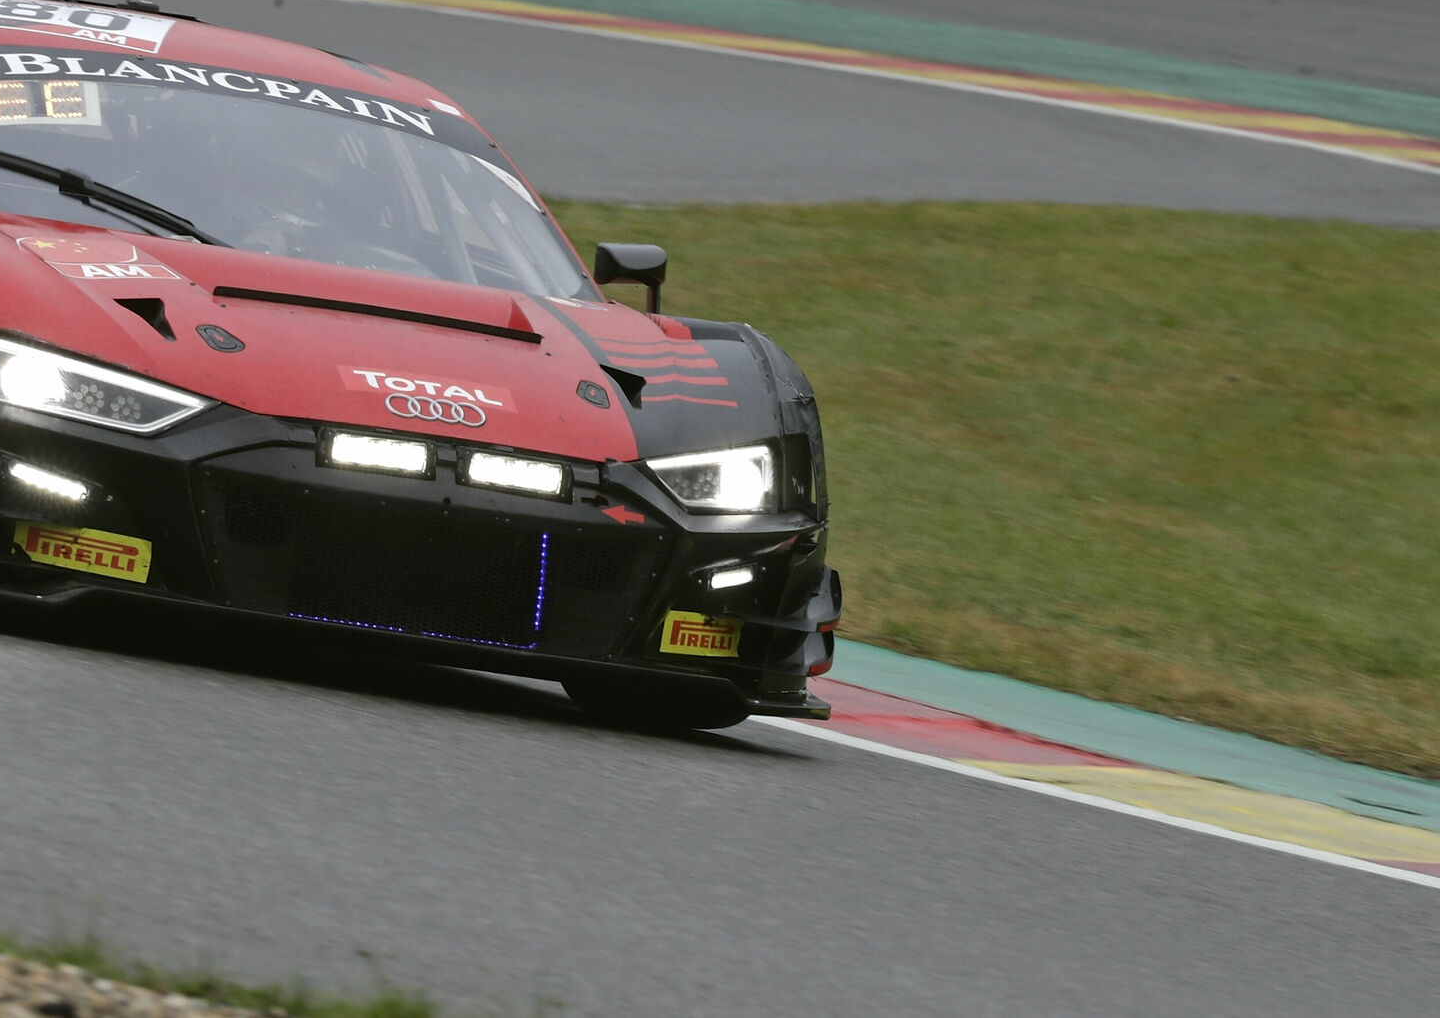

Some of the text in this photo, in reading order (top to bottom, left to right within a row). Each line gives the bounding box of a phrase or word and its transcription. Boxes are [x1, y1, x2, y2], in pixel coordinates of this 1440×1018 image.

[71, 29, 127, 45] AM
[80, 262, 155, 280] AM
[352, 369, 503, 407] TOTAL
[25, 526, 140, 573] PIRELLI
[669, 620, 735, 650] PIRELLI
